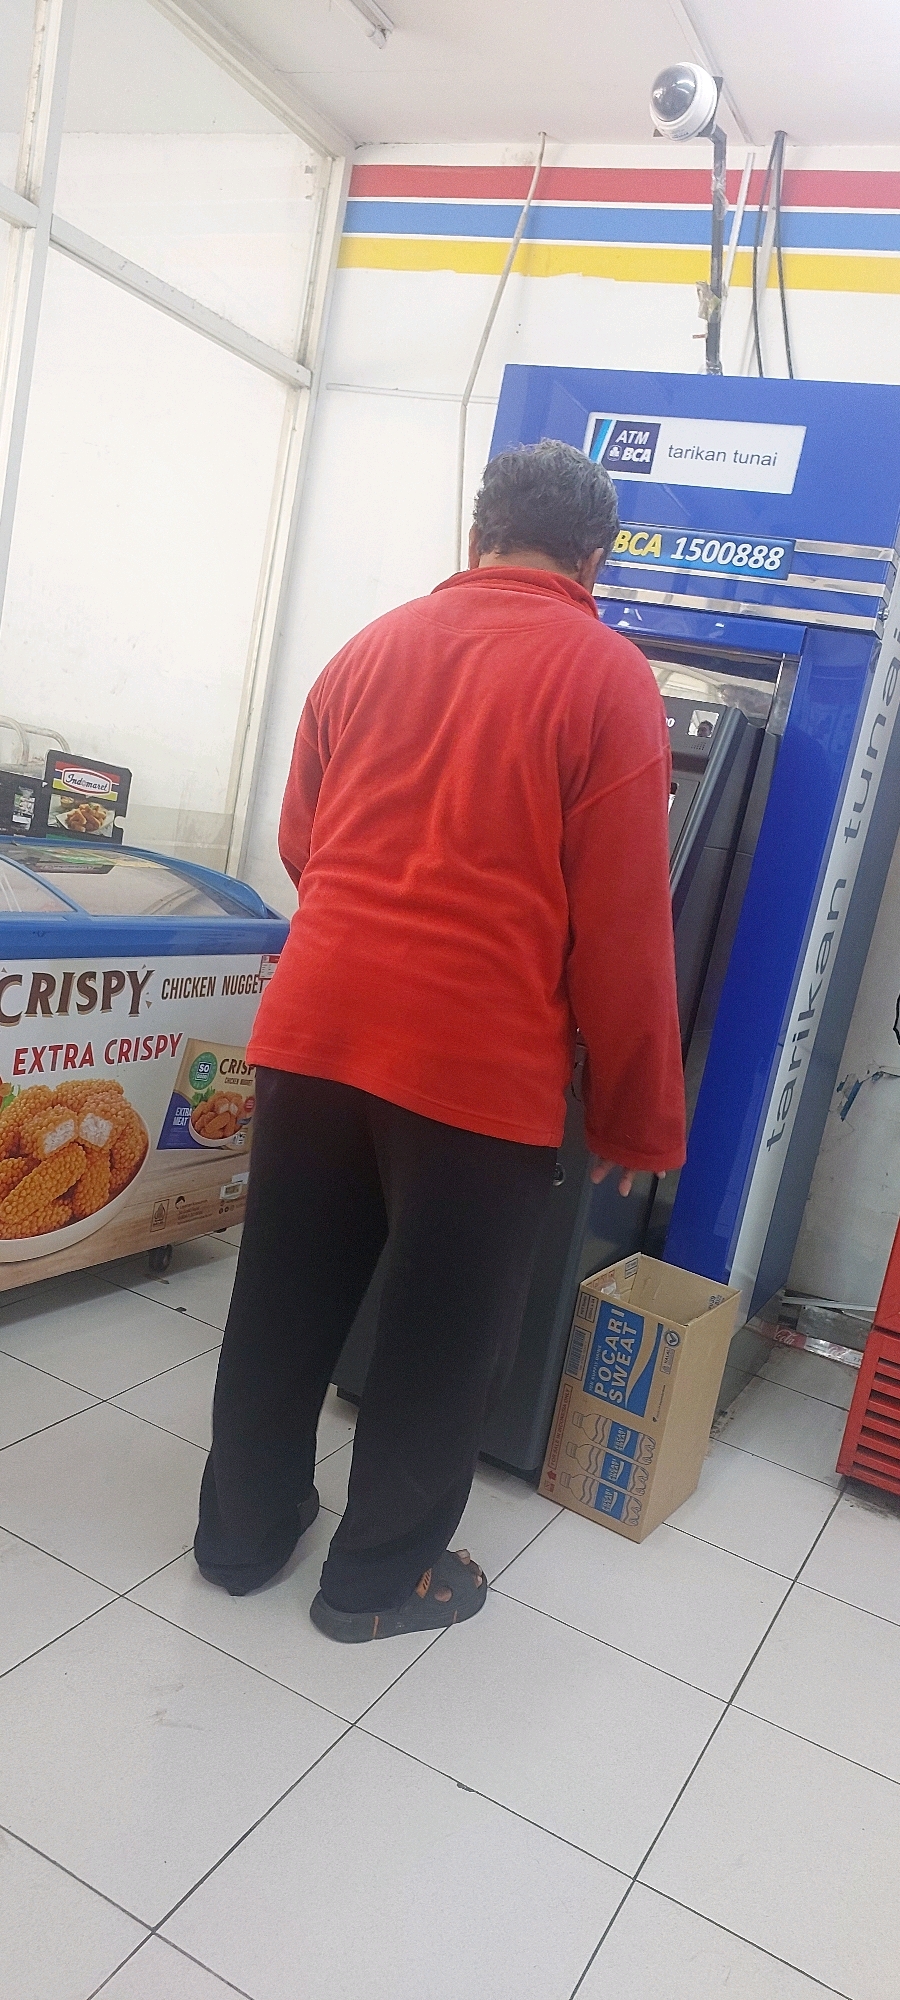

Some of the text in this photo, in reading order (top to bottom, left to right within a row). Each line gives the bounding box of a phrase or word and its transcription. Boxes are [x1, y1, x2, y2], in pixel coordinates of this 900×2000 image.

[615, 430, 649, 445] ATM
[621, 447, 652, 463] BCA
[668, 444, 778, 467] tarikan tunai
[613, 530, 785, 571] BCA 1500888
[66, 773, 107, 791] Indomaret
[0, 970, 155, 1027] CRISPY
[161, 976, 216, 1000] CHICKEN
[767, 879, 846, 1152] tarikan
[12, 1032, 183, 1076] EXTRA CRISPY
[198, 1063, 210, 1073] SO
[173, 1117, 189, 1126] MEAT
[175, 1107, 192, 1116] EXTRA
[594, 1309, 625, 1398] POCARI
[609, 1322, 637, 1403] SWEAT
[558, 1404, 567, 1433] INDONESIA
